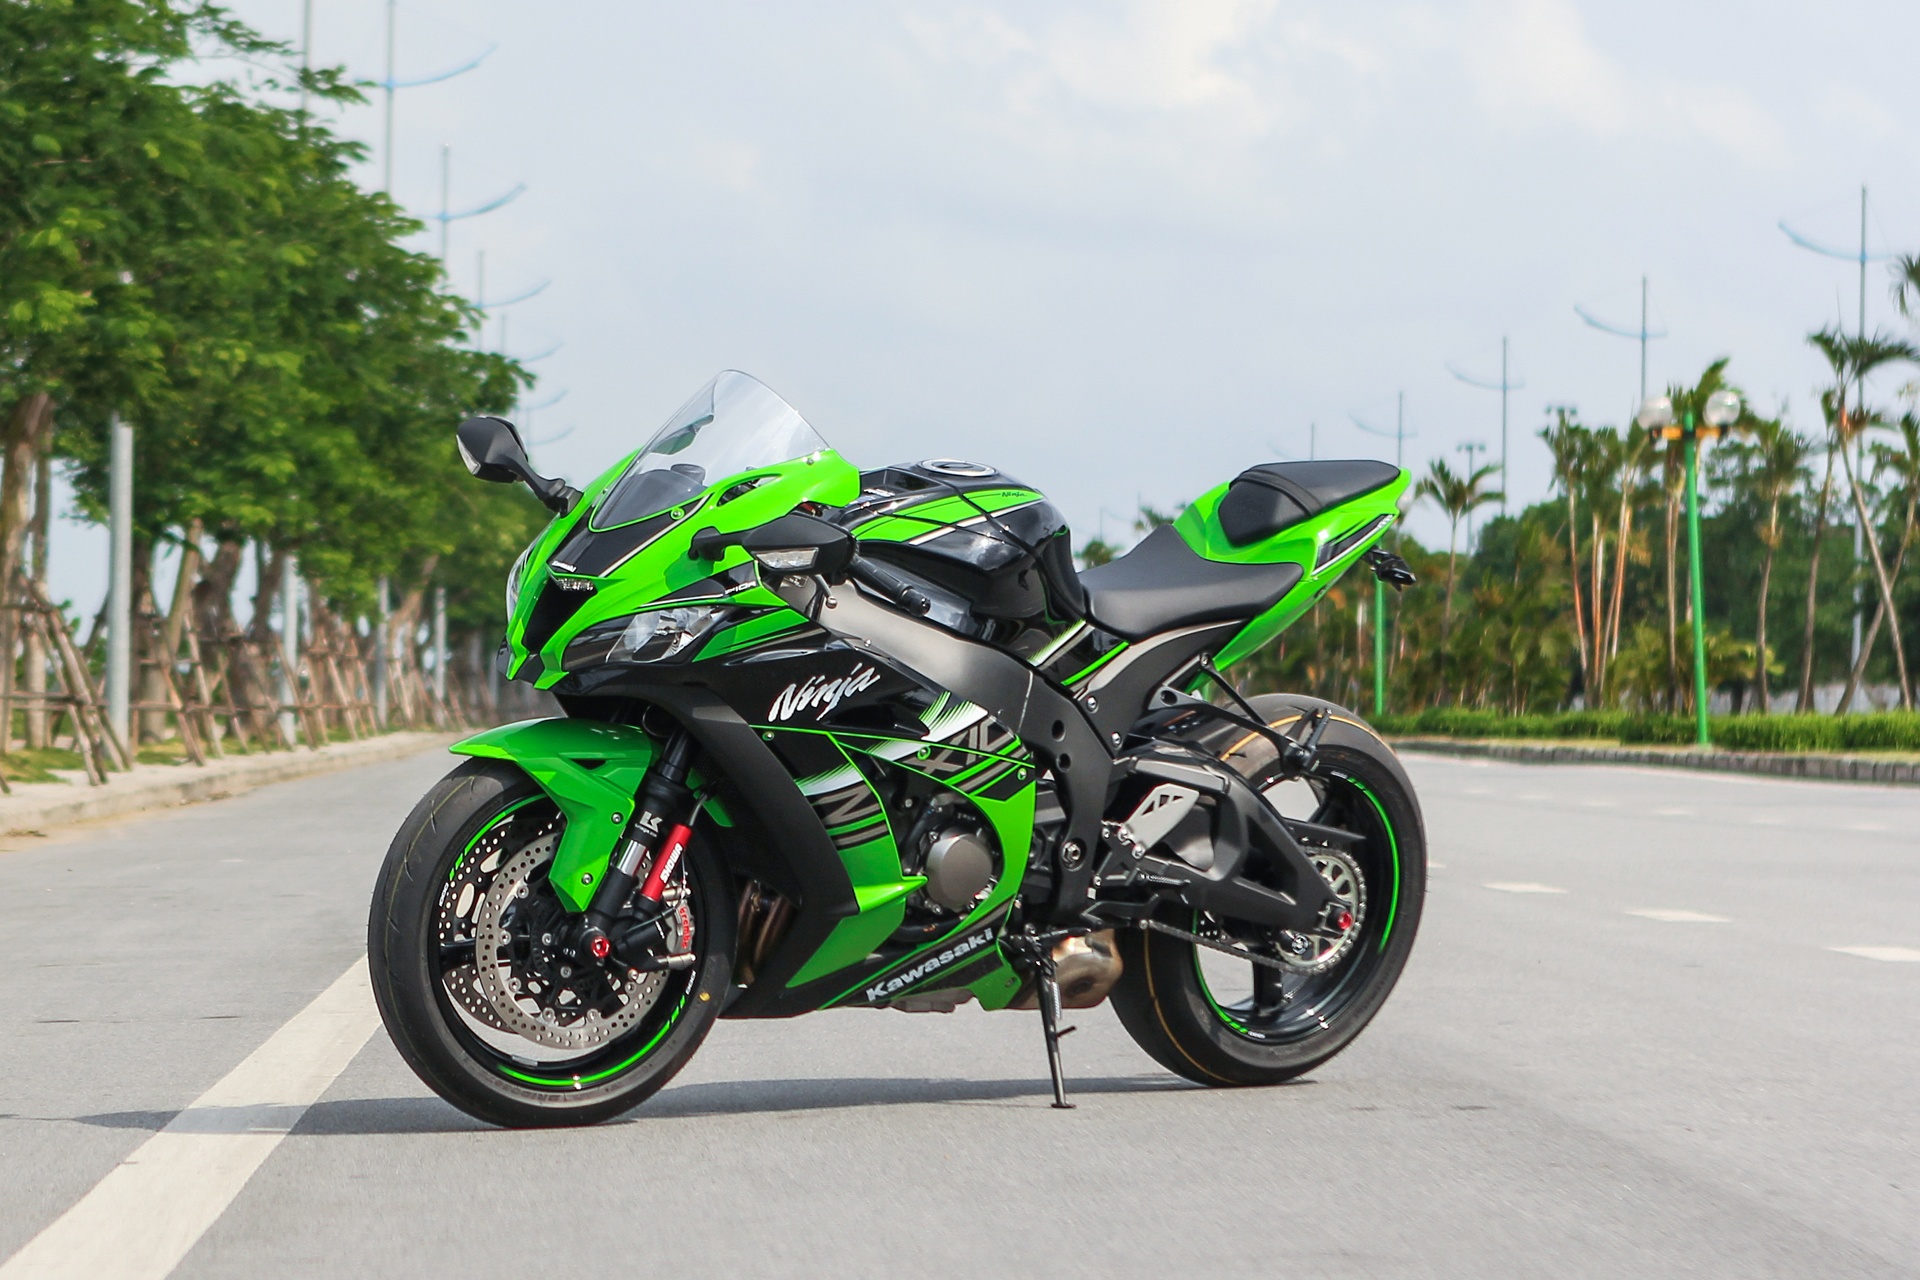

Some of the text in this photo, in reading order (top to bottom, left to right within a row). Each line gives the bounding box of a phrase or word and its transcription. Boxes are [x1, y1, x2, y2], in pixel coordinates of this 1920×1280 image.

[767, 662, 881, 722] Ninja
[659, 842, 683, 884] SHOWA
[865, 927, 994, 1002] Kawasaki
